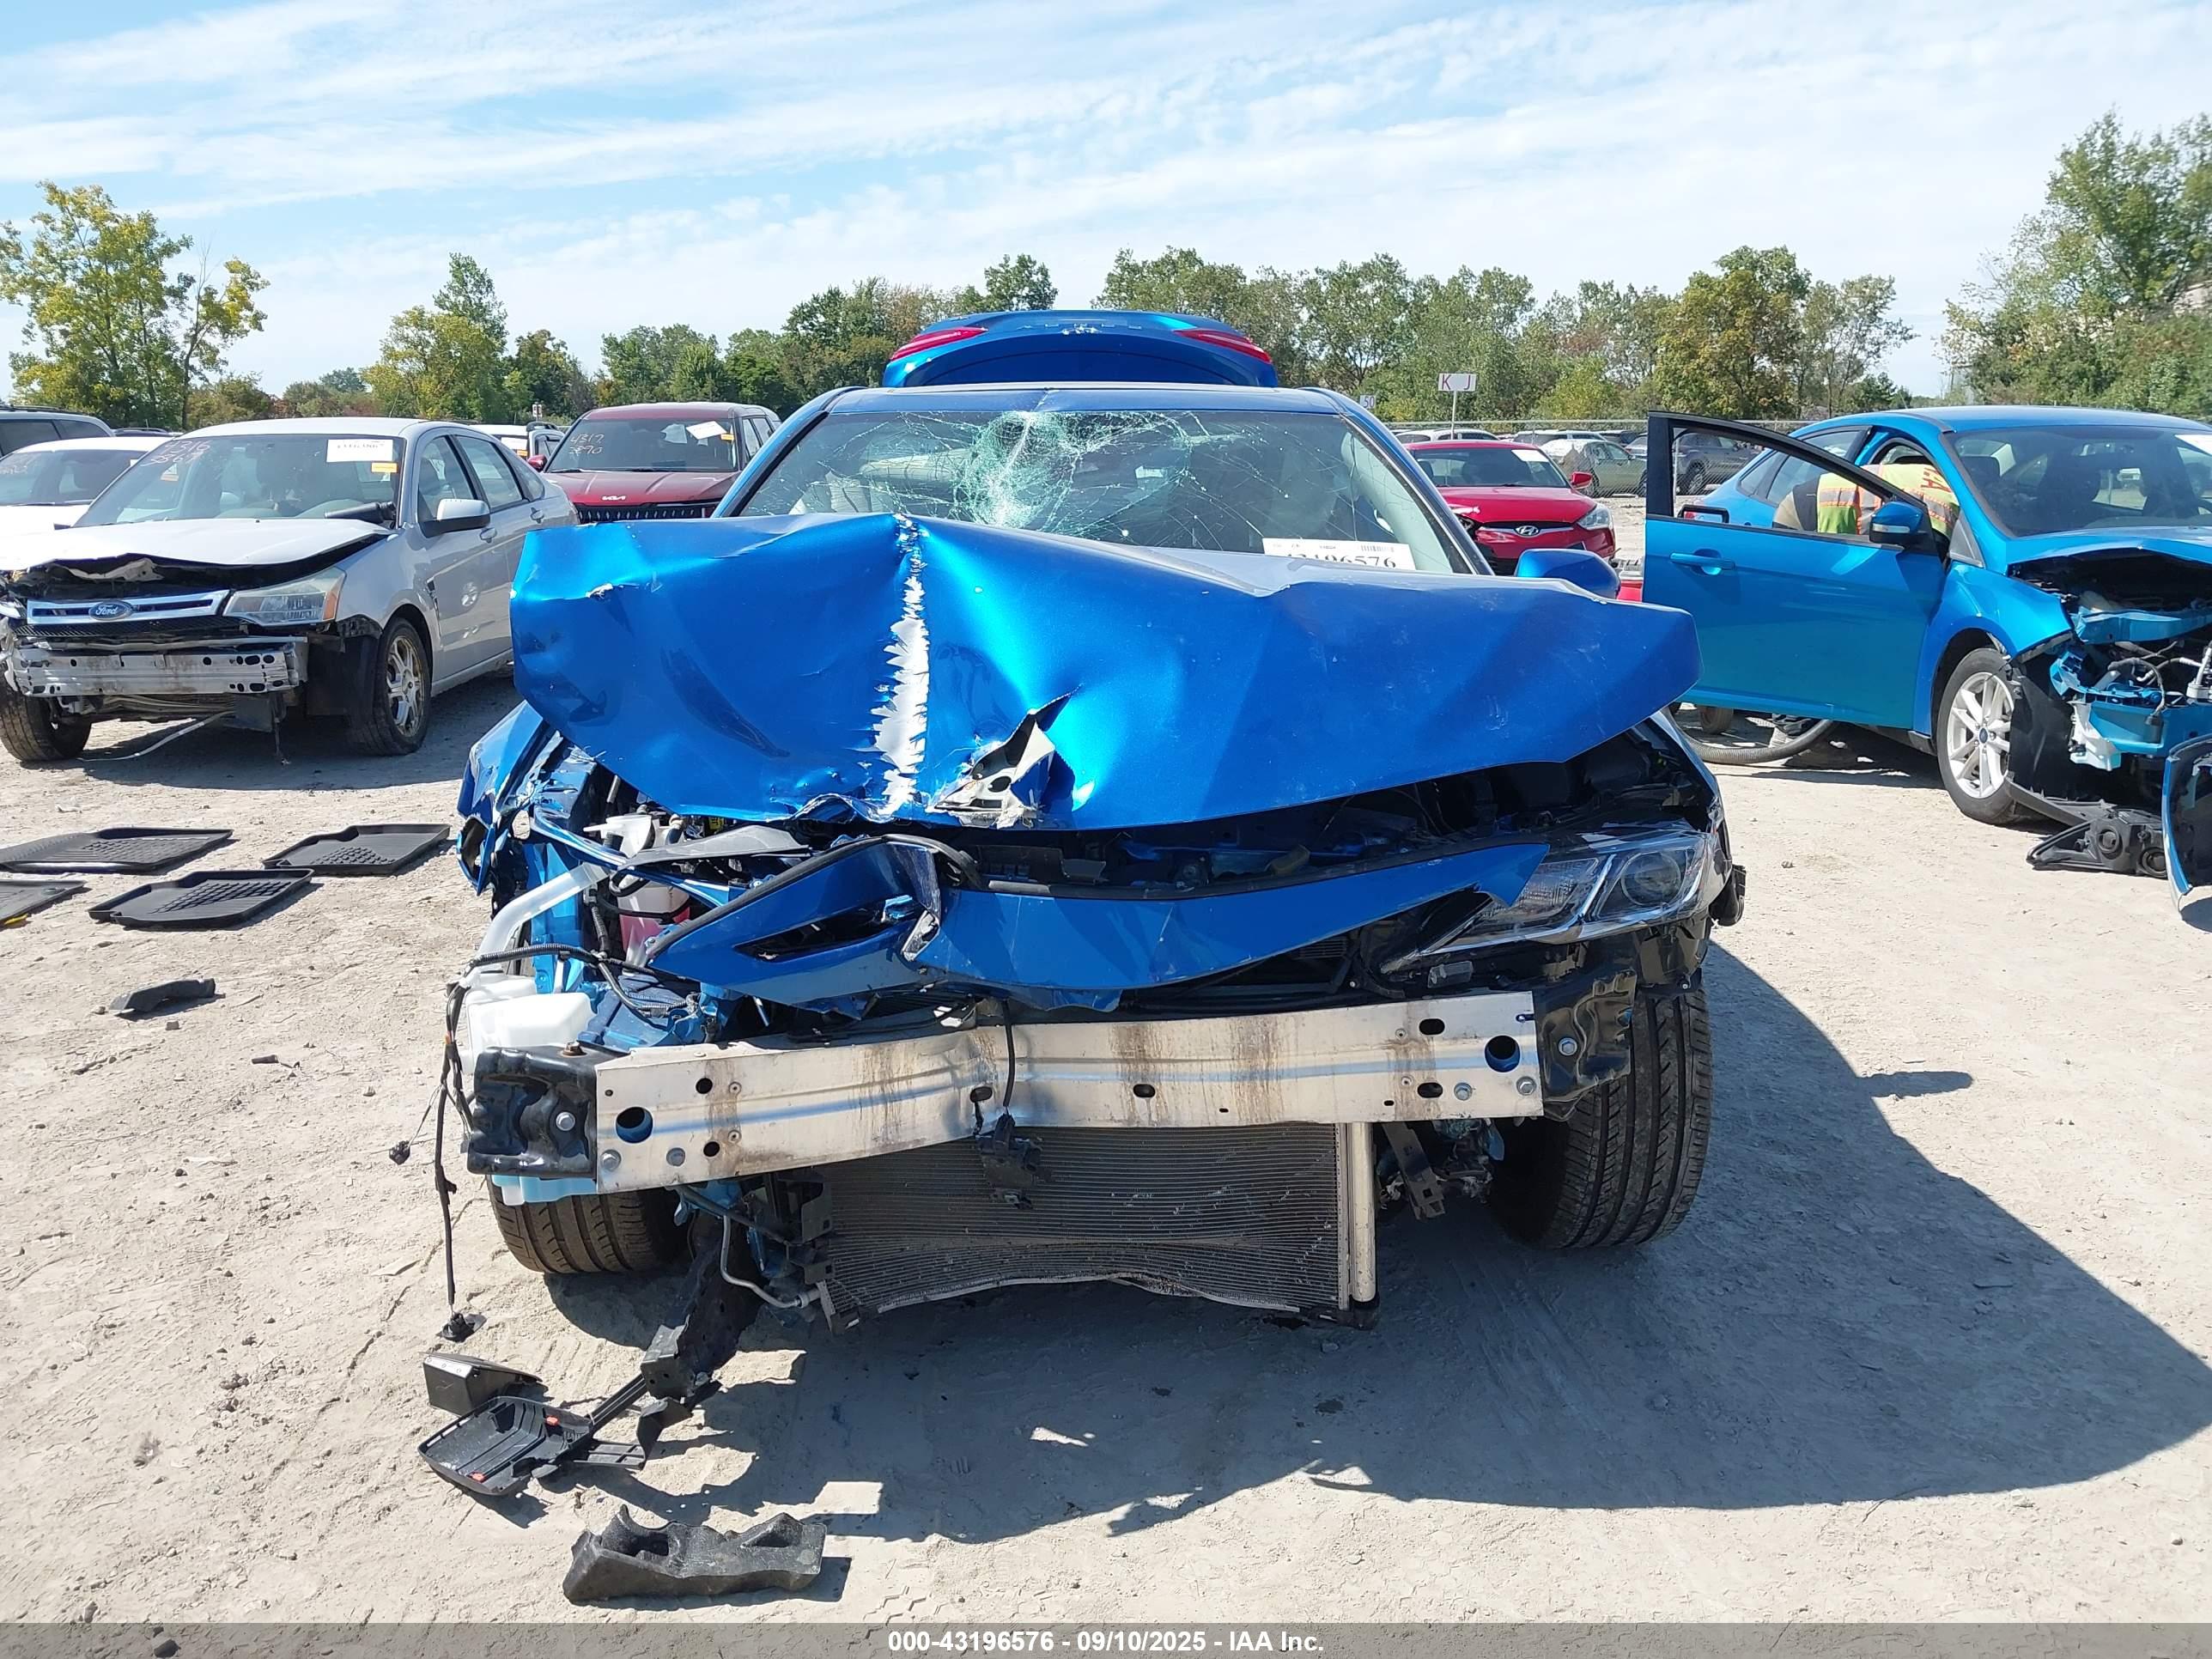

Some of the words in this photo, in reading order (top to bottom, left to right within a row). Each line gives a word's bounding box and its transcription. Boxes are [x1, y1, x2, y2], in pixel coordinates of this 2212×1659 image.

[1442, 374, 1452, 391] K
[1463, 374, 1471, 391] J
[1364, 396, 1375, 409] 50
[95, 605, 118, 616] Ford
